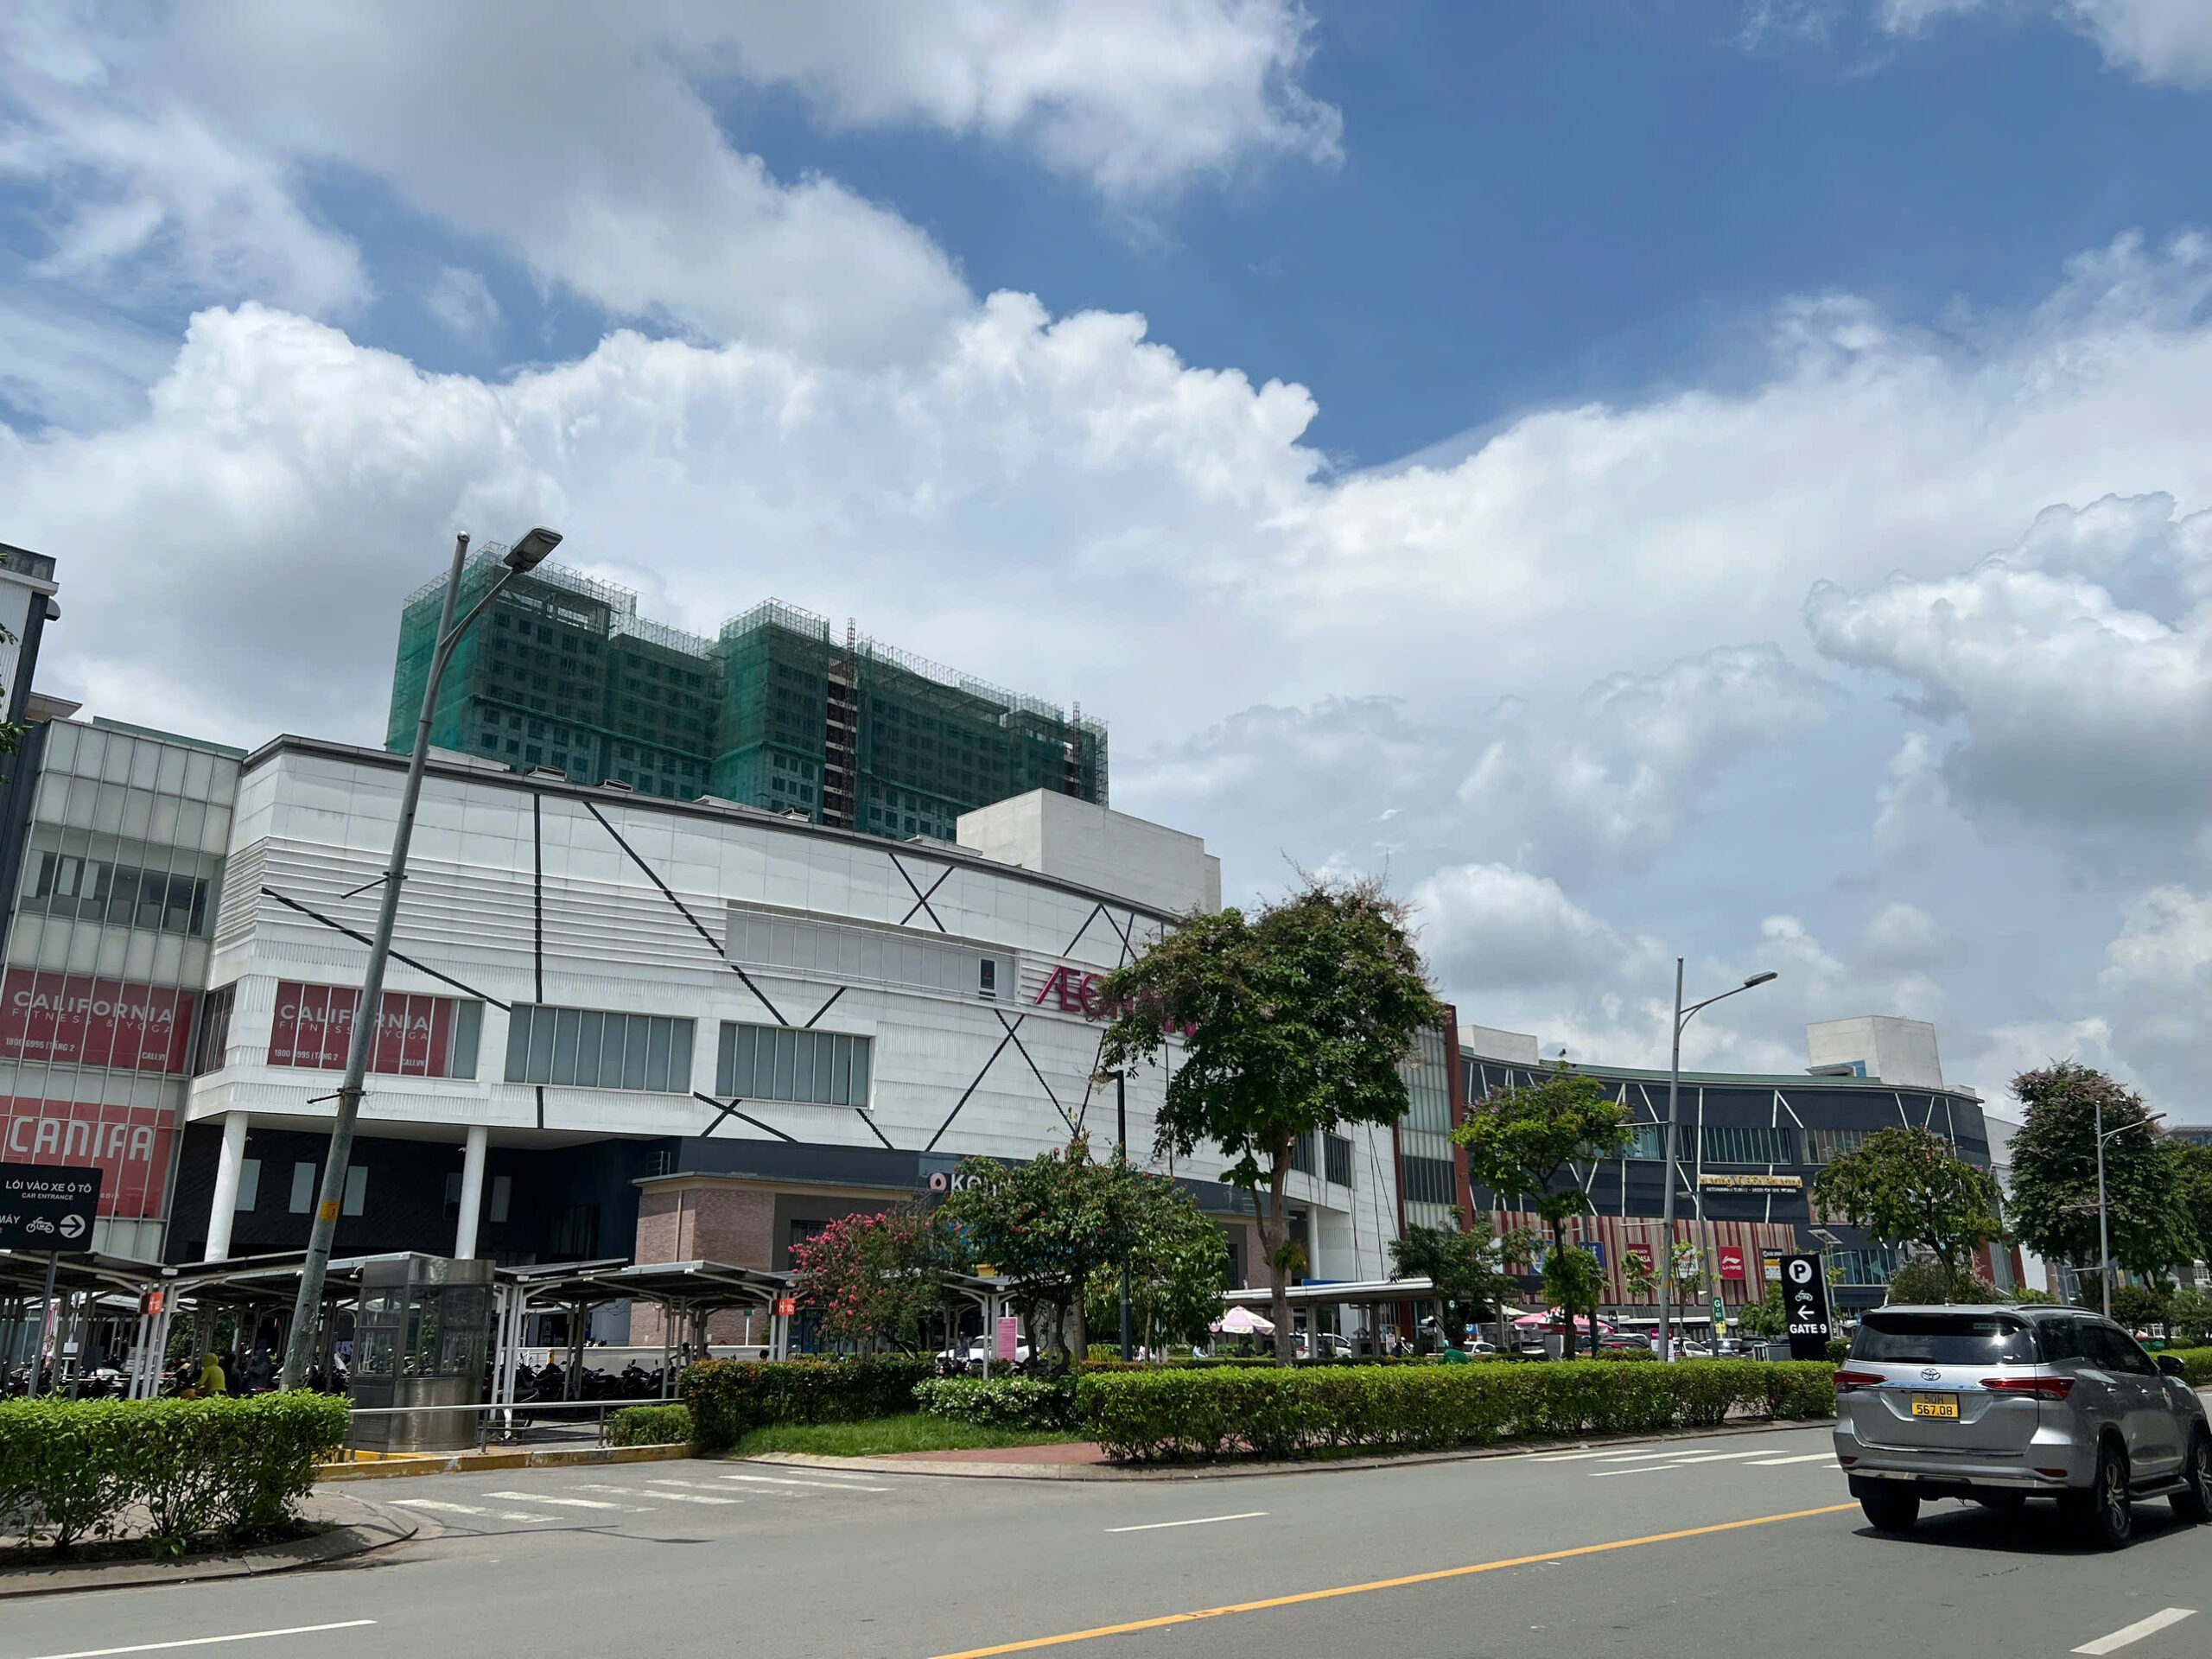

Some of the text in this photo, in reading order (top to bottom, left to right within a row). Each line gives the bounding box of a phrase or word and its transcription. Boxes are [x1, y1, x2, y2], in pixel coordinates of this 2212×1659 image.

[13, 990, 173, 1023] CALIFORNIA
[11, 1007, 92, 1025] FITNESS
[125, 1020, 173, 1033] YOGA
[280, 1004, 429, 1031] CALIFRNIA
[385, 1029, 428, 1040] YOGA
[25, 1039, 45, 1049] 6995
[69, 1044, 75, 1052] 2
[274, 1049, 291, 1058] 1800
[10, 1116, 153, 1161] CANIFA
[50, 1183, 66, 1192] XE
[67, 1182, 76, 1192] Ô
[78, 1183, 92, 1193] TÔ
[1789, 1323, 1827, 1334] GATE 9
[1916, 1403, 1954, 1416] 567.08
